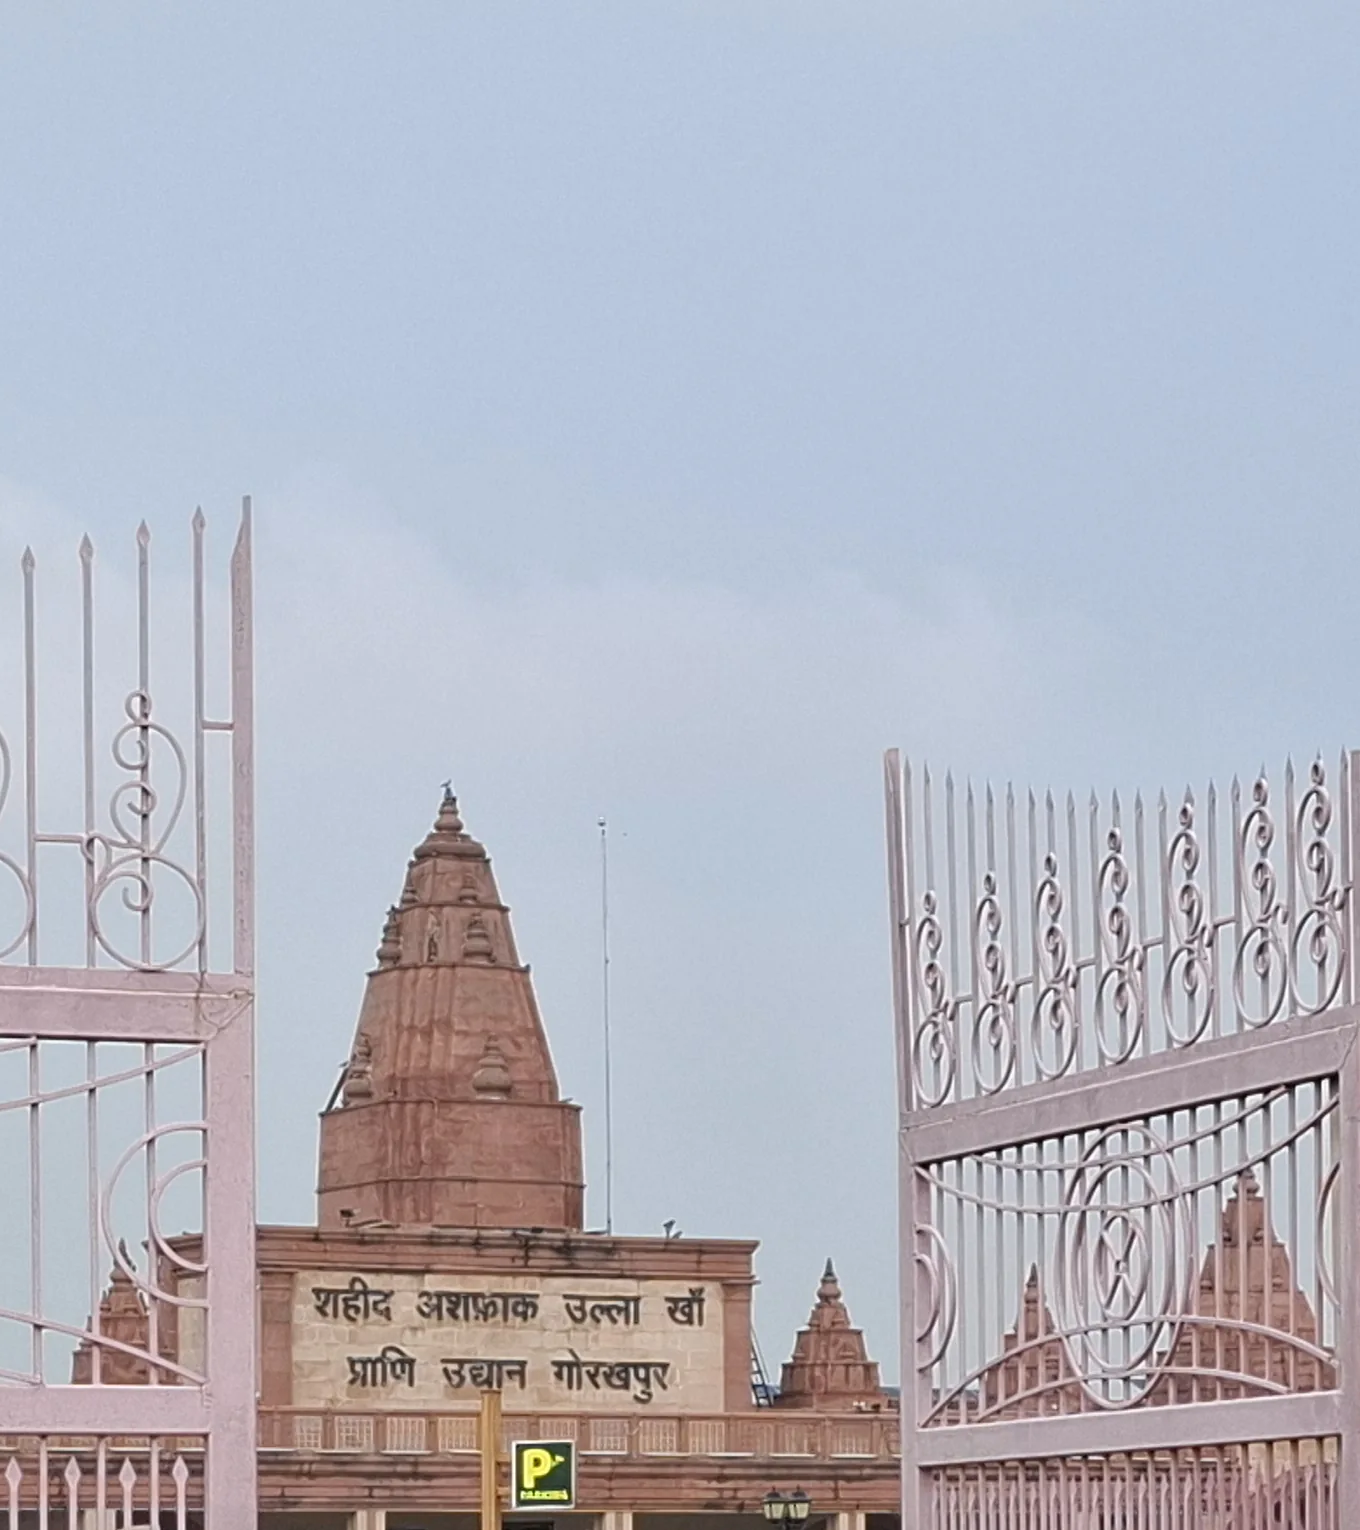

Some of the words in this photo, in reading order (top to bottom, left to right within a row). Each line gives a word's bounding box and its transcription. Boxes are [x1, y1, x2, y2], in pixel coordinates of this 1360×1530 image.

[311, 1277, 394, 1323] शहीद
[563, 1294, 642, 1326] उल्ला
[347, 1345, 416, 1389] प्राणि
[441, 1357, 528, 1390] उद्यान
[550, 1348, 671, 1404] गोरखपुर
